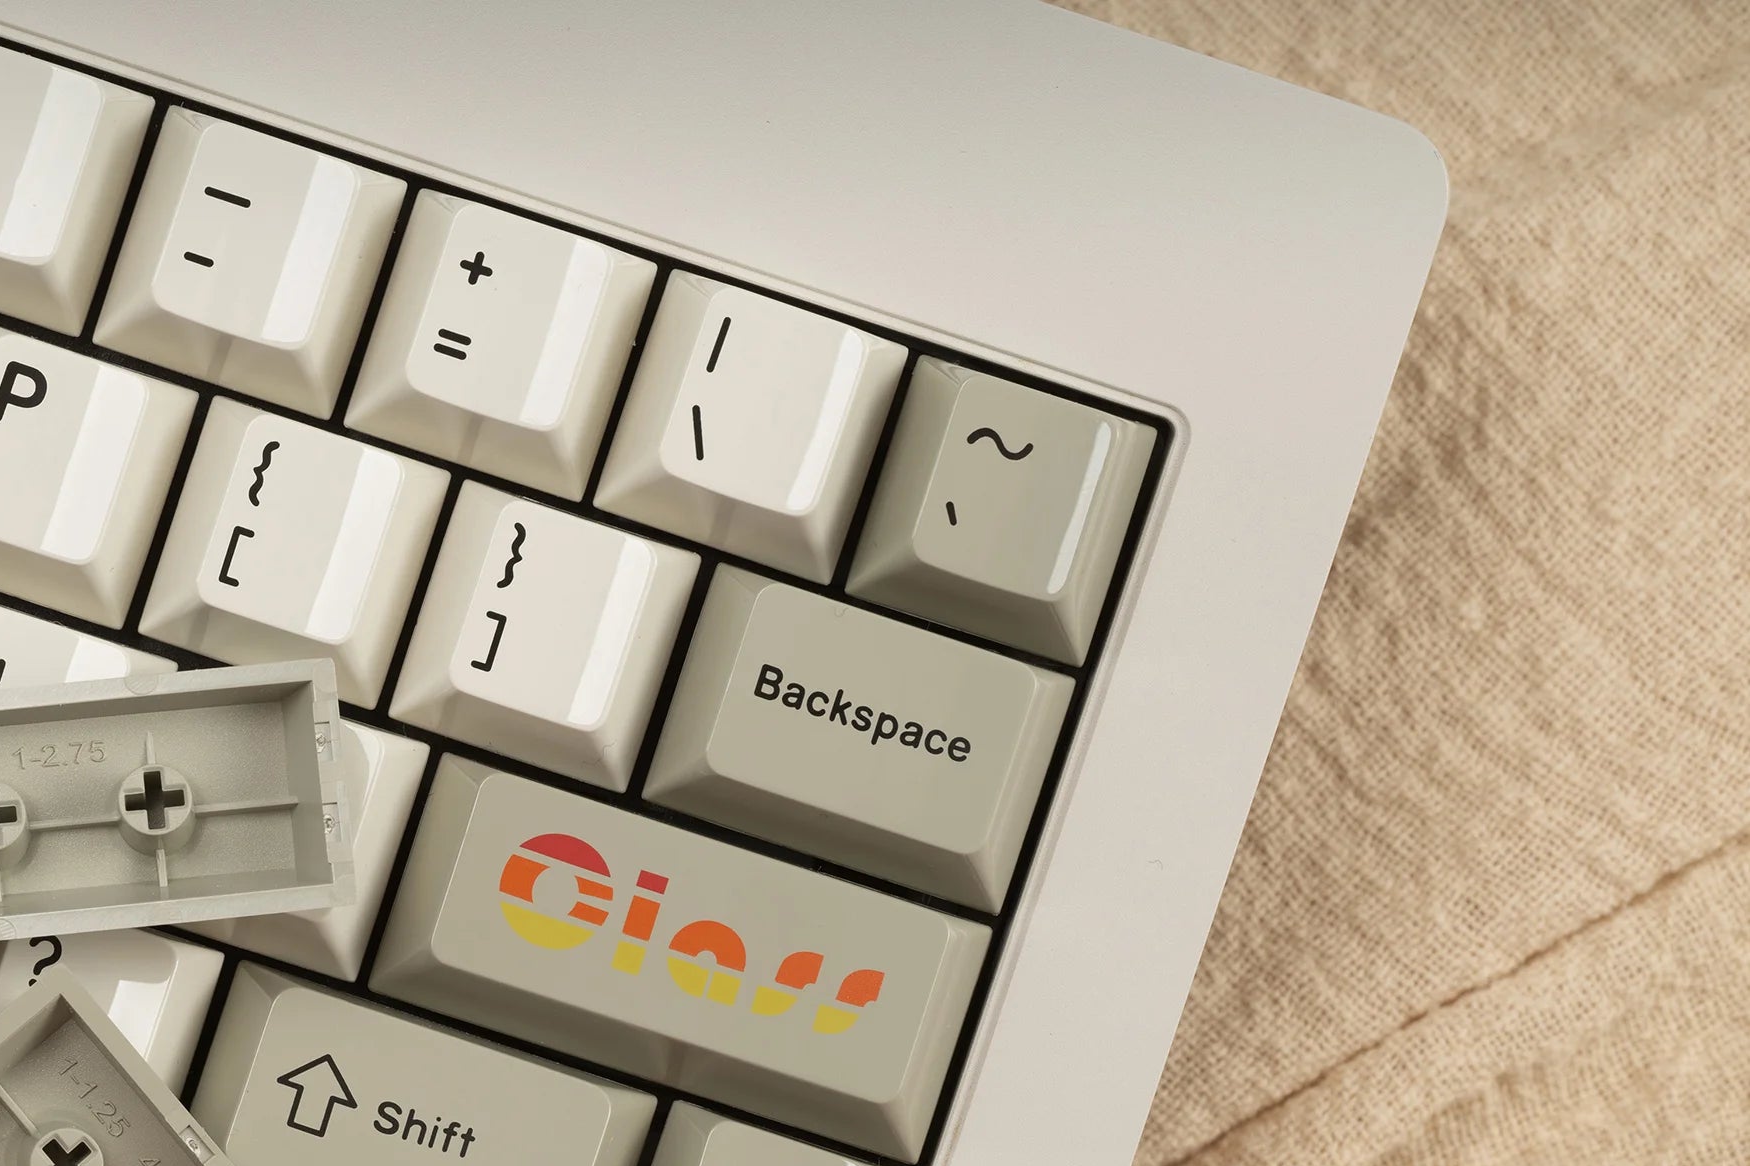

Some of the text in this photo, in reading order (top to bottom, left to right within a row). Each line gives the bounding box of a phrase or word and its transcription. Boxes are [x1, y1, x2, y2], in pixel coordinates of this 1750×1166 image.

[460, 252, 492, 285] +
[434, 329, 471, 360] =
[967, 428, 1033, 460] ~
[249, 441, 280, 506] {
[219, 526, 254, 587] [
[497, 523, 526, 588] }
[471, 611, 507, 672] ]
[754, 664, 970, 762] Backspace
[11, 740, 106, 770] 1-2.75
[29, 936, 62, 986] ?
[58, 1056, 131, 1138] 1-1.25
[374, 1102, 475, 1158] Shift
